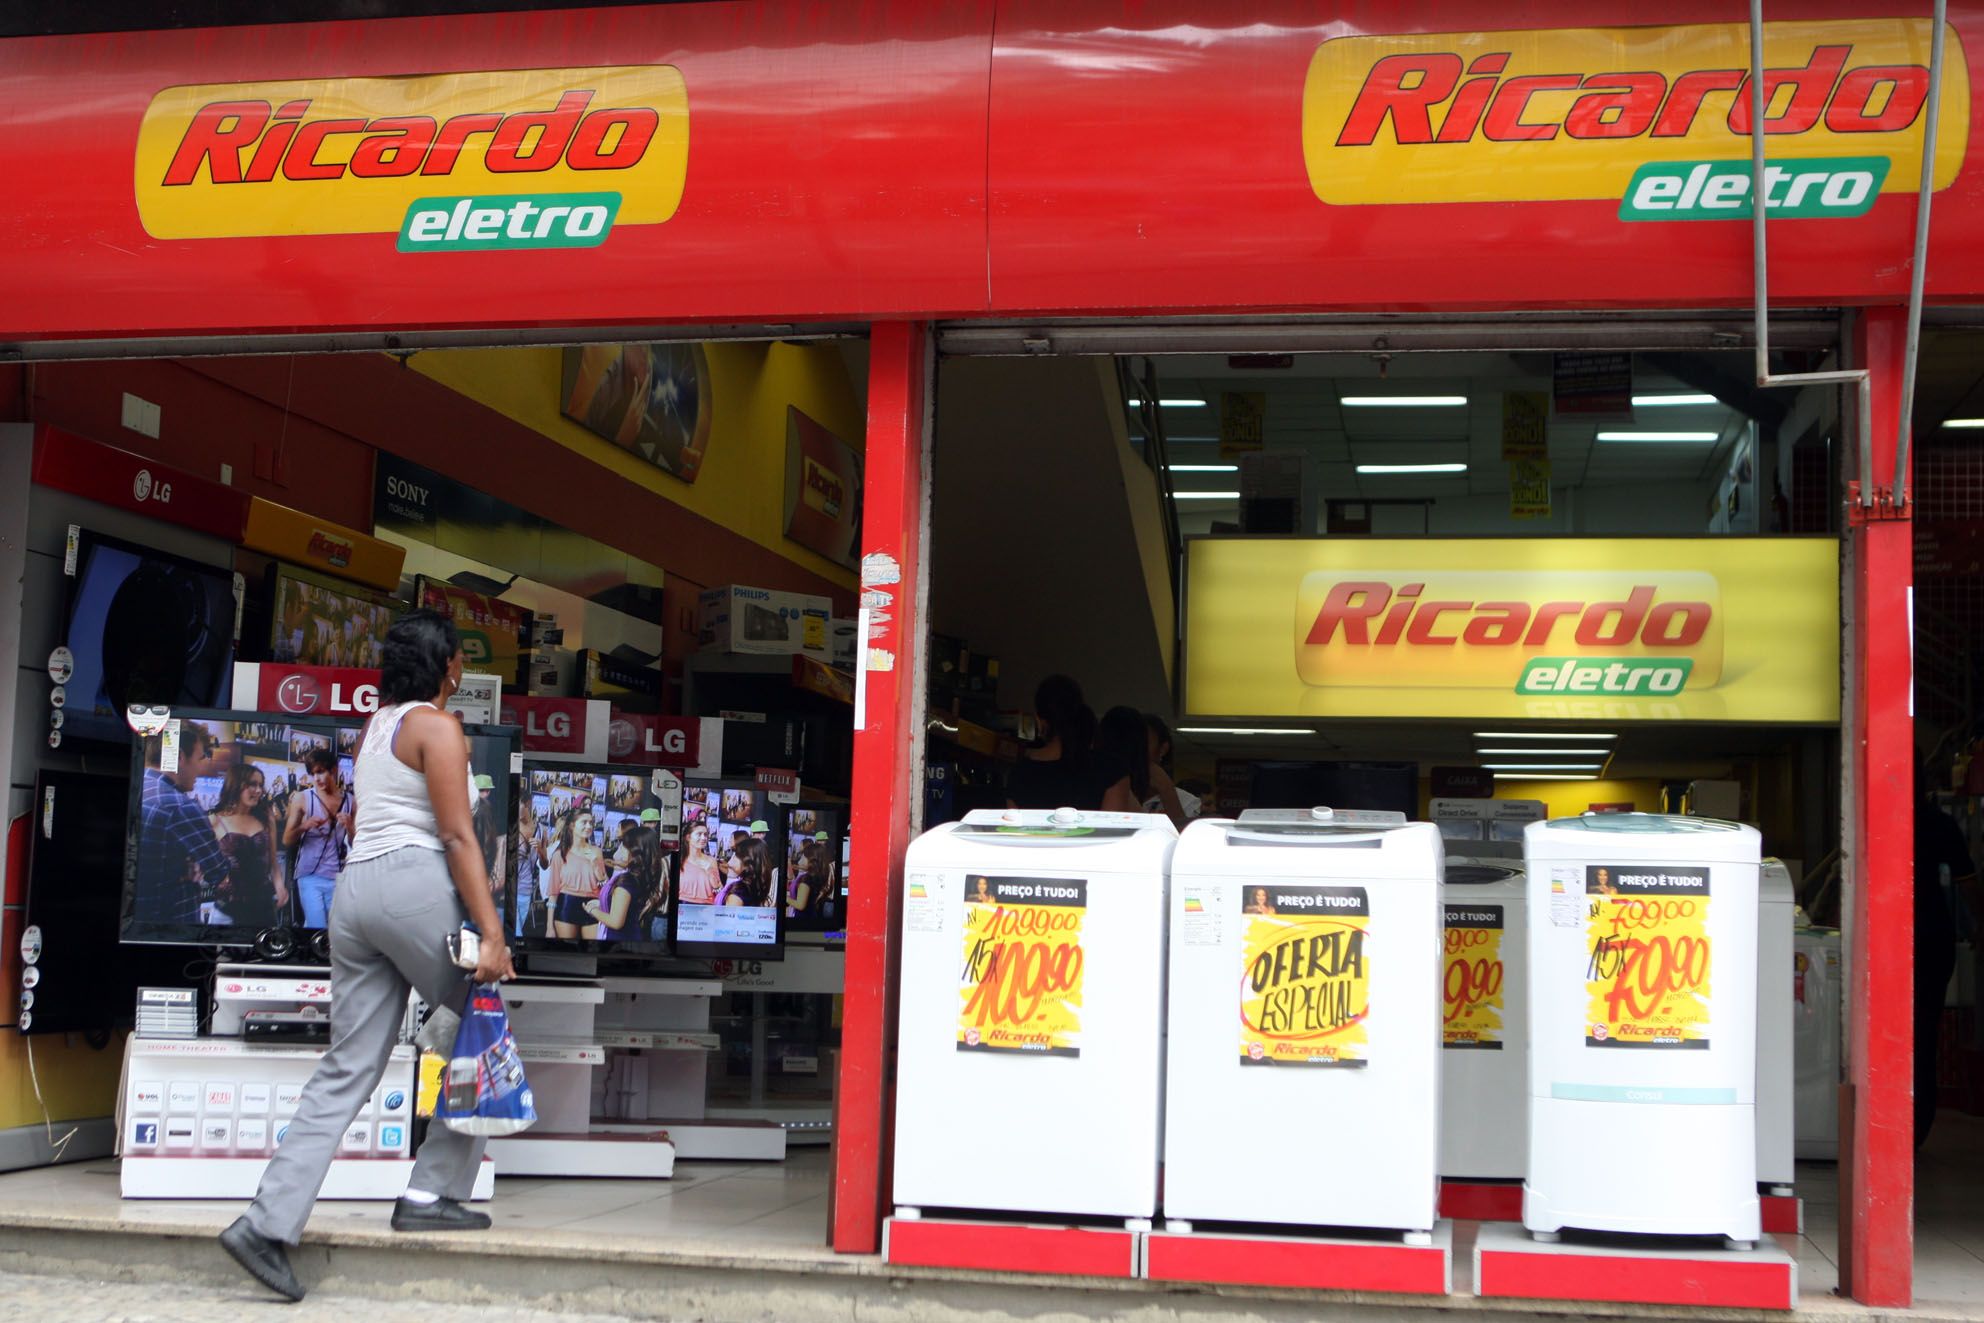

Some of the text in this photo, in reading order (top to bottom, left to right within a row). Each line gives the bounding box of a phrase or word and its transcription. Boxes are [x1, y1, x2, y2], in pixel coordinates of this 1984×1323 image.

[1335, 44, 1930, 146] Ricardo
[162, 90, 659, 186] Ricardo
[1632, 163, 1874, 209] eletro
[408, 199, 608, 241] eletro
[152, 480, 172, 504] LG
[387, 475, 429, 506] SONY
[733, 587, 769, 600] PHILIPS
[1305, 581, 1713, 646] Ricardo
[1524, 657, 1684, 691] eletro
[330, 683, 380, 713] LG
[526, 711, 571, 738] LG
[645, 727, 686, 753] LG
[657, 780, 679, 790] LED
[758, 773, 791, 786] NETFLIX
[1447, 775, 1478, 786] CAIXA
[1618, 873, 1703, 889] PREÇO É TUDO!
[997, 884, 1079, 899] PREÇO É TUDO!
[1277, 893, 1361, 909] PREÇO É TUDO!
[1460, 911, 1467, 921] É
[1467, 912, 1496, 921] TUDO!
[737, 961, 763, 976] LG
[1251, 929, 1364, 993] OFERTA
[755, 977, 774, 987] Good
[1259, 980, 1360, 1032] ESPECIAL
[989, 1030, 1051, 1044] Ricardo
[1618, 1024, 1683, 1037] Ricardo
[147, 1044, 228, 1053] HOME THEATER
[1274, 1042, 1338, 1056] Ricardo
[1626, 1089, 1664, 1101] Consul
